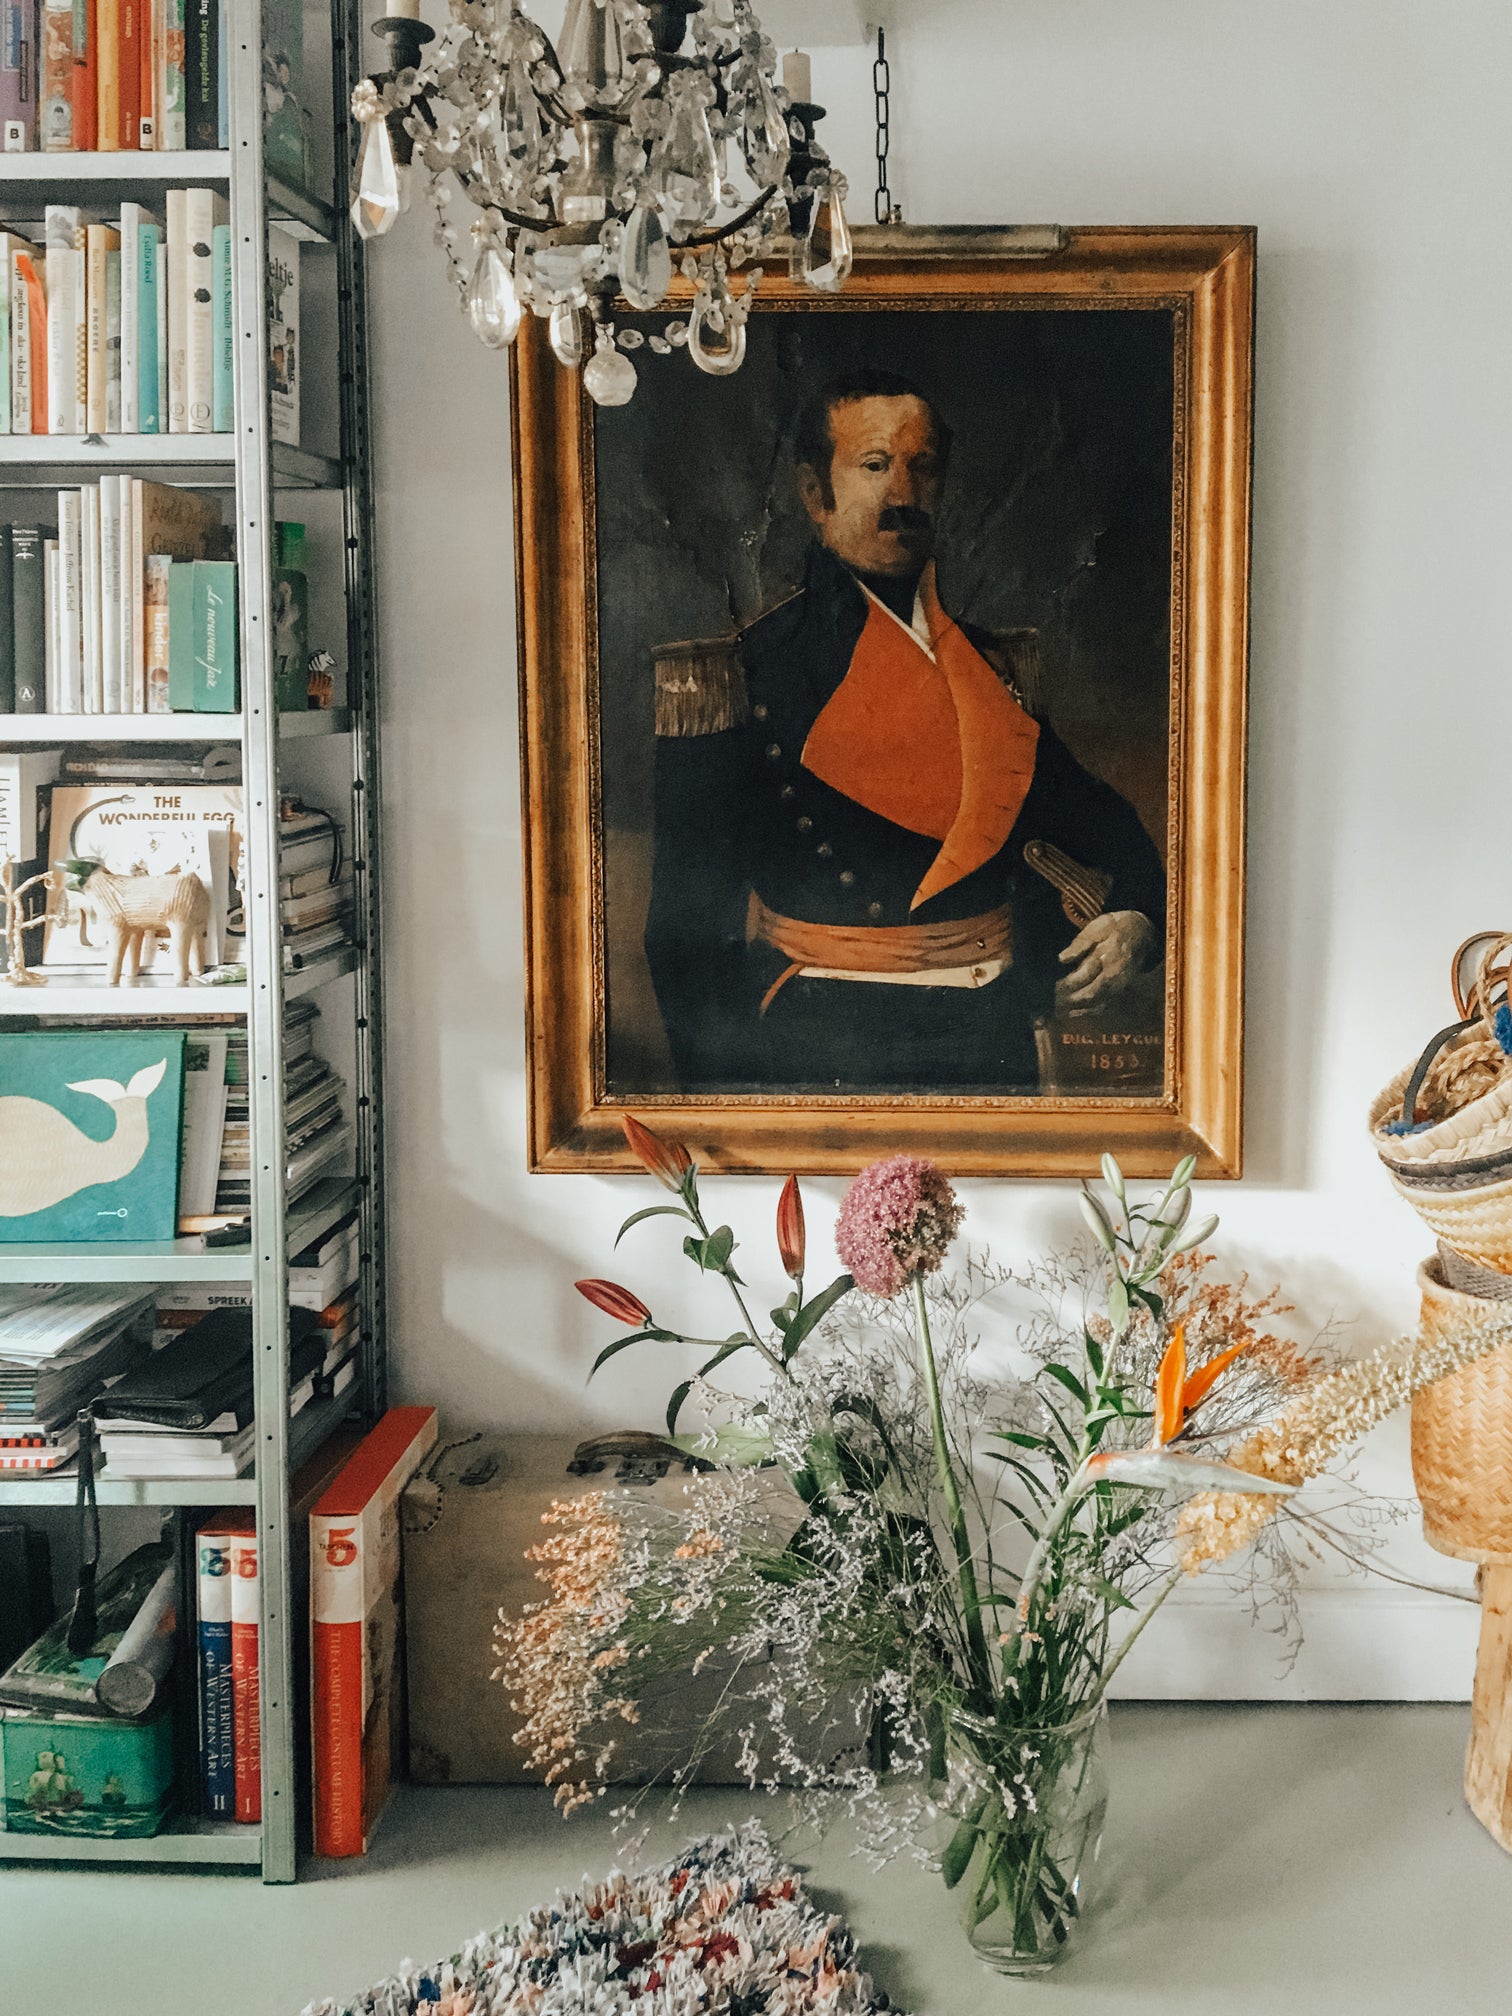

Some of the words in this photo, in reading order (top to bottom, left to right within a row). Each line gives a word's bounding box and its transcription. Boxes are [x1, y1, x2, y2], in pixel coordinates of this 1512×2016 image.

[10, 128, 19, 139] B
[143, 123, 152, 134] B
[143, 235, 153, 259] Lydia
[223, 239, 233, 264] Annie
[143, 260, 153, 284] Rood
[223, 290, 233, 329] Schmidt
[206, 585, 223, 605] Le
[153, 613, 167, 661] kinder
[206, 608, 216, 661] nouveau
[153, 796, 181, 808] THE
[207, 1295, 248, 1306] SPREEK
[328, 1527, 358, 1567] 5
[205, 1650, 214, 1669] OF
[330, 1630, 341, 1656] THE
[330, 1659, 342, 1725] COMPLETE
[205, 1677, 218, 1745] WESTERN
[219, 1663, 232, 1769] MASTERPIECES
[235, 1677, 248, 1747] WESTERN
[247, 1665, 260, 1772] MASTERPIECES
[206, 1749, 218, 1779] ART
[331, 1727, 343, 1789] COSTUME
[331, 1791, 343, 1847] HISTORY
